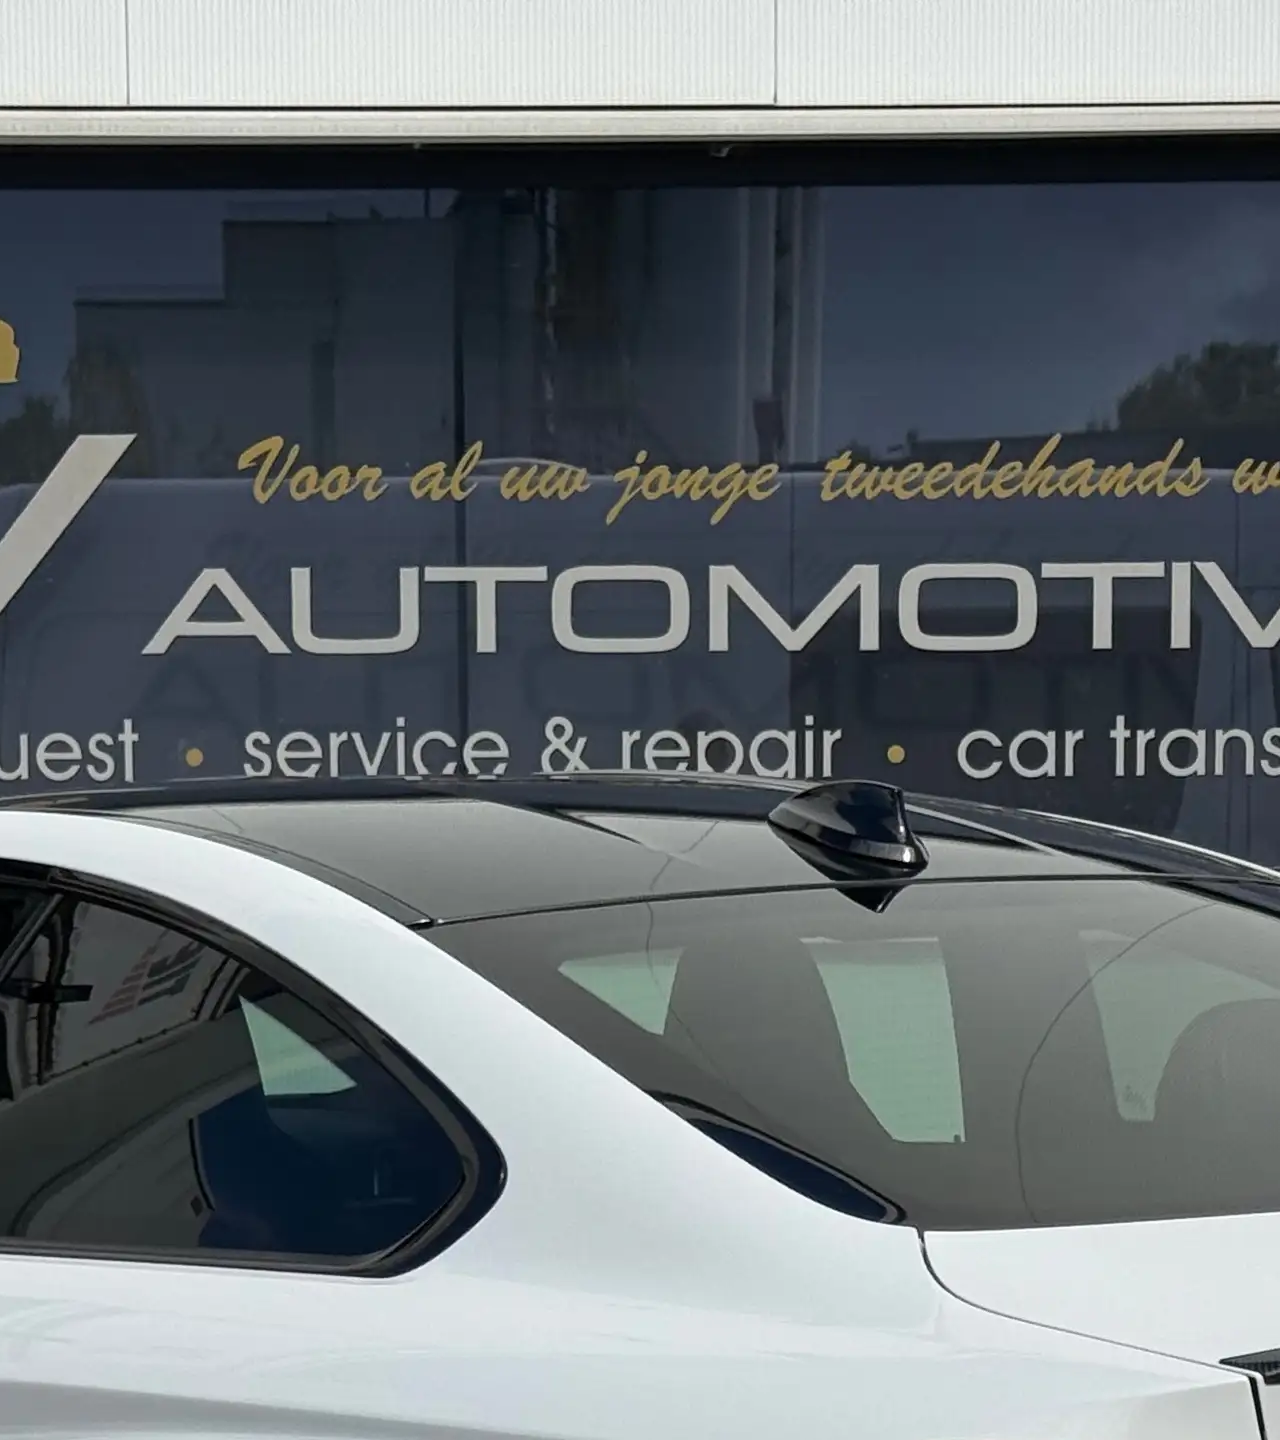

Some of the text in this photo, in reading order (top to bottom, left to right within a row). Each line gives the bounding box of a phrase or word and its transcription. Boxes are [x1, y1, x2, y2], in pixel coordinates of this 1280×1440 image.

[237, 435, 389, 504] Voor
[410, 440, 483, 502] al
[499, 461, 591, 502] uw
[605, 449, 782, 526] jonge
[820, 433, 1216, 502] tweedehands
[243, 715, 510, 781] service
[540, 715, 588, 781] &
[620, 714, 843, 781] repair
[956, 728, 1085, 780] car
